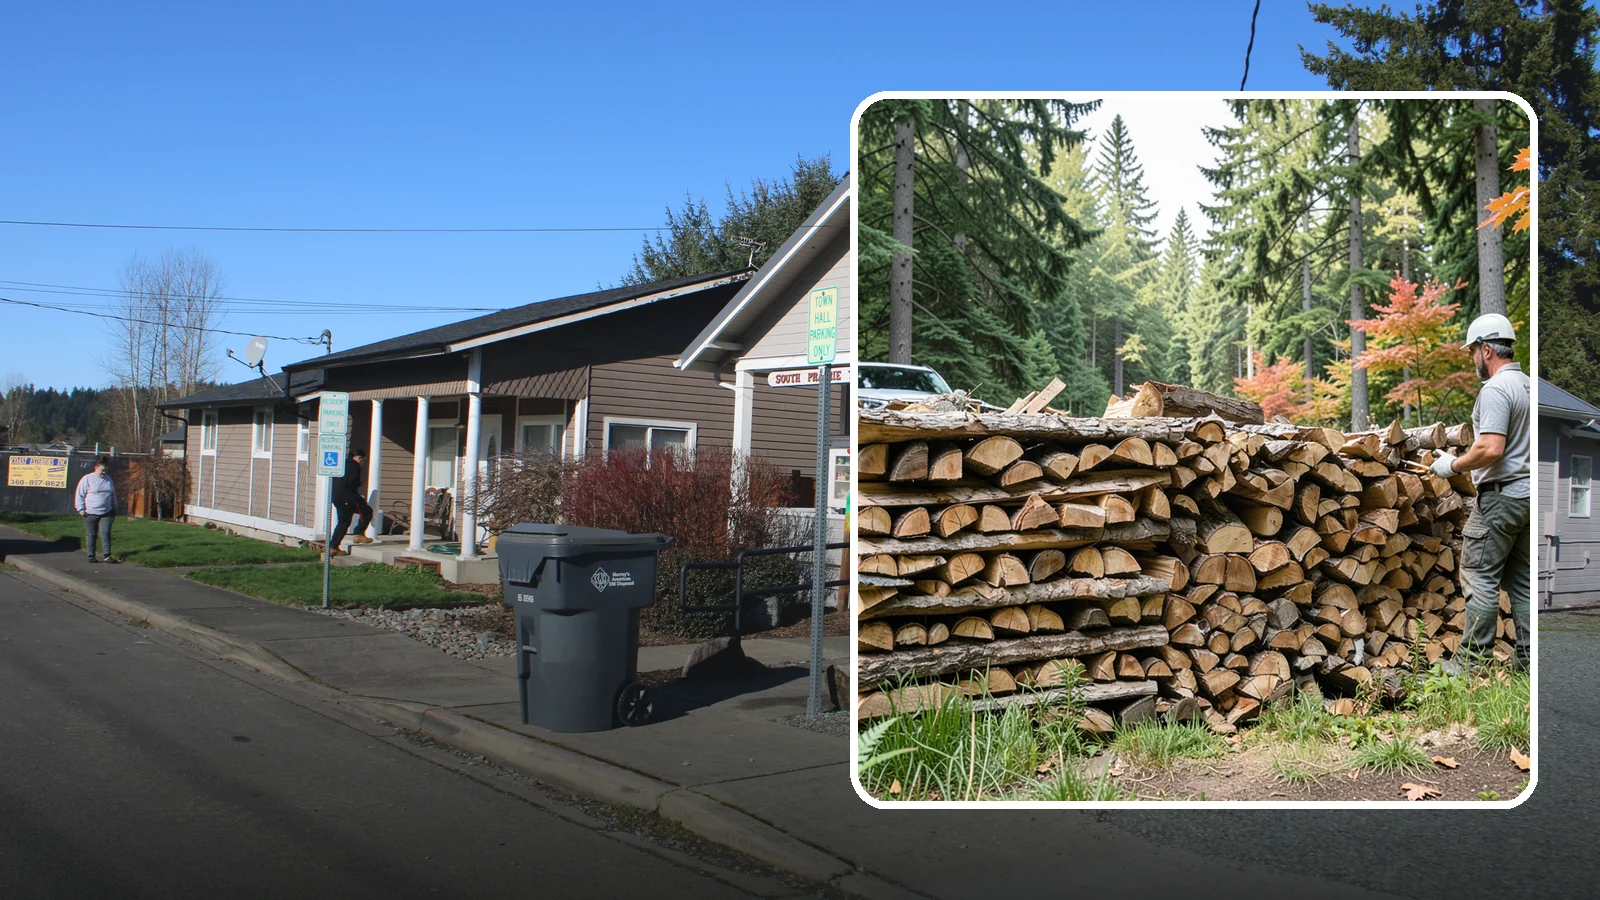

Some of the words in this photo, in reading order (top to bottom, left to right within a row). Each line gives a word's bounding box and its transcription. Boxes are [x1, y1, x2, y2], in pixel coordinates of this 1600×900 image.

[815, 294, 833, 308] TOWN
[814, 311, 831, 324] HALL
[810, 326, 836, 340] PARKING
[814, 344, 831, 357] ONLY
[776, 374, 801, 384] SOUTH
